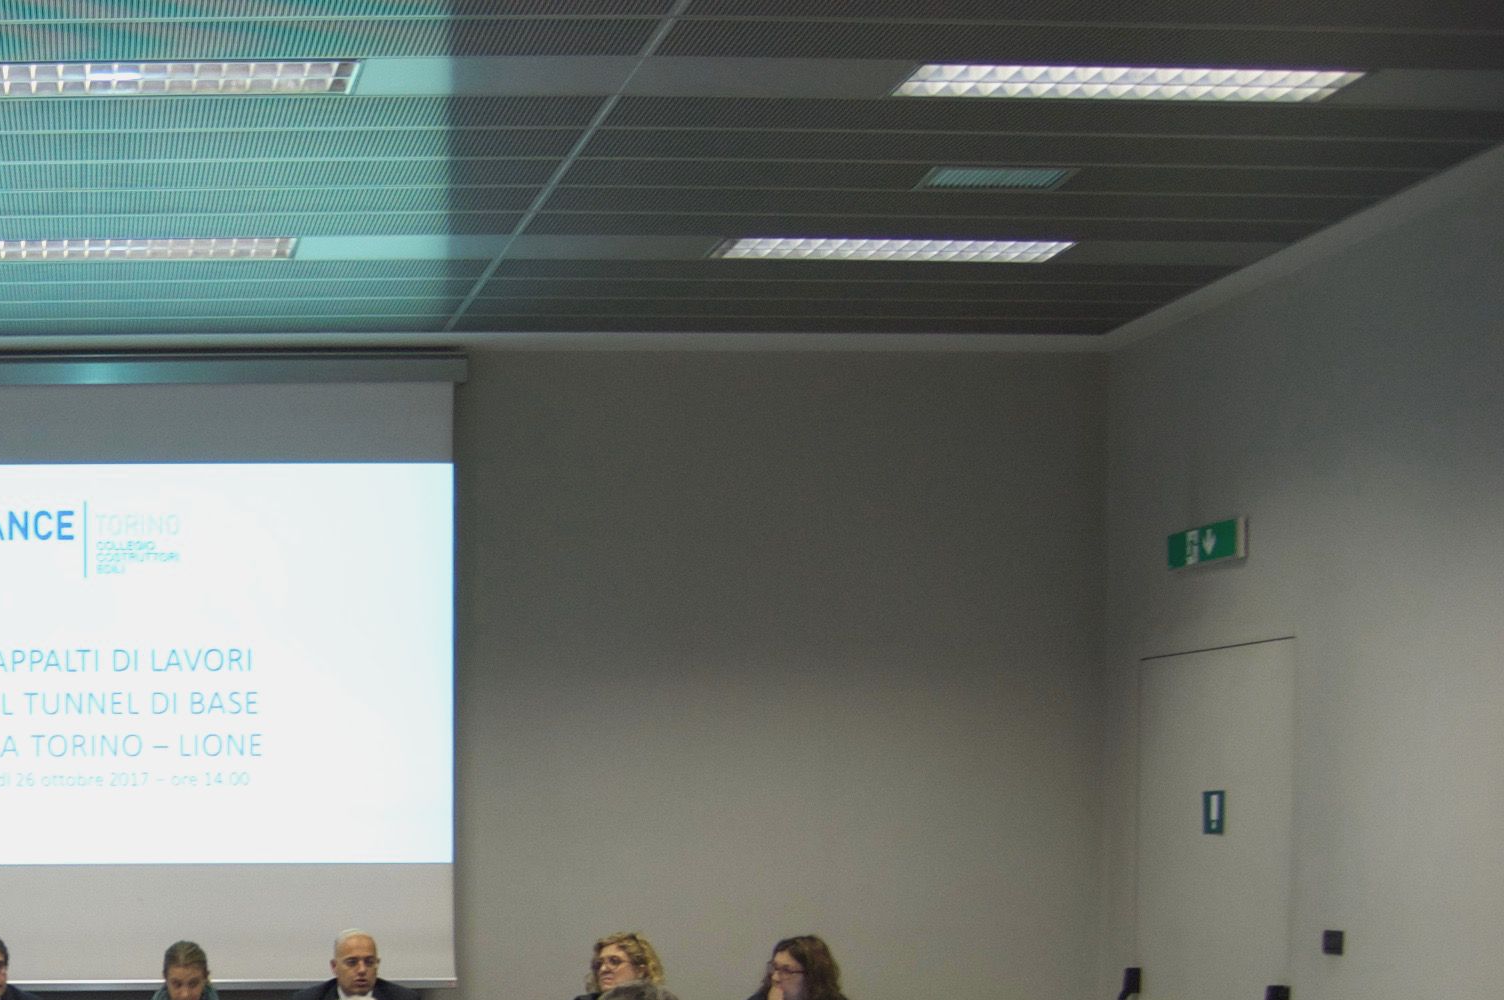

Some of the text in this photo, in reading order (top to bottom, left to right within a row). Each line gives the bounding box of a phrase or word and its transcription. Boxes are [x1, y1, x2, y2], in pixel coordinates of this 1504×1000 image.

[95, 513, 180, 535] TORINO
[95, 540, 156, 551] COLLEGIO
[112, 648, 139, 672] DI
[150, 647, 253, 672] LAVORI
[23, 691, 140, 716] TUNNEL
[151, 691, 177, 715] DI
[189, 690, 258, 715] BASE
[31, 733, 143, 758] TORINO
[180, 733, 262, 757] LIONE
[15, 771, 36, 788] 26
[40, 771, 104, 788] ottobre
[108, 771, 150, 788] 2017
[169, 774, 199, 788] ore
